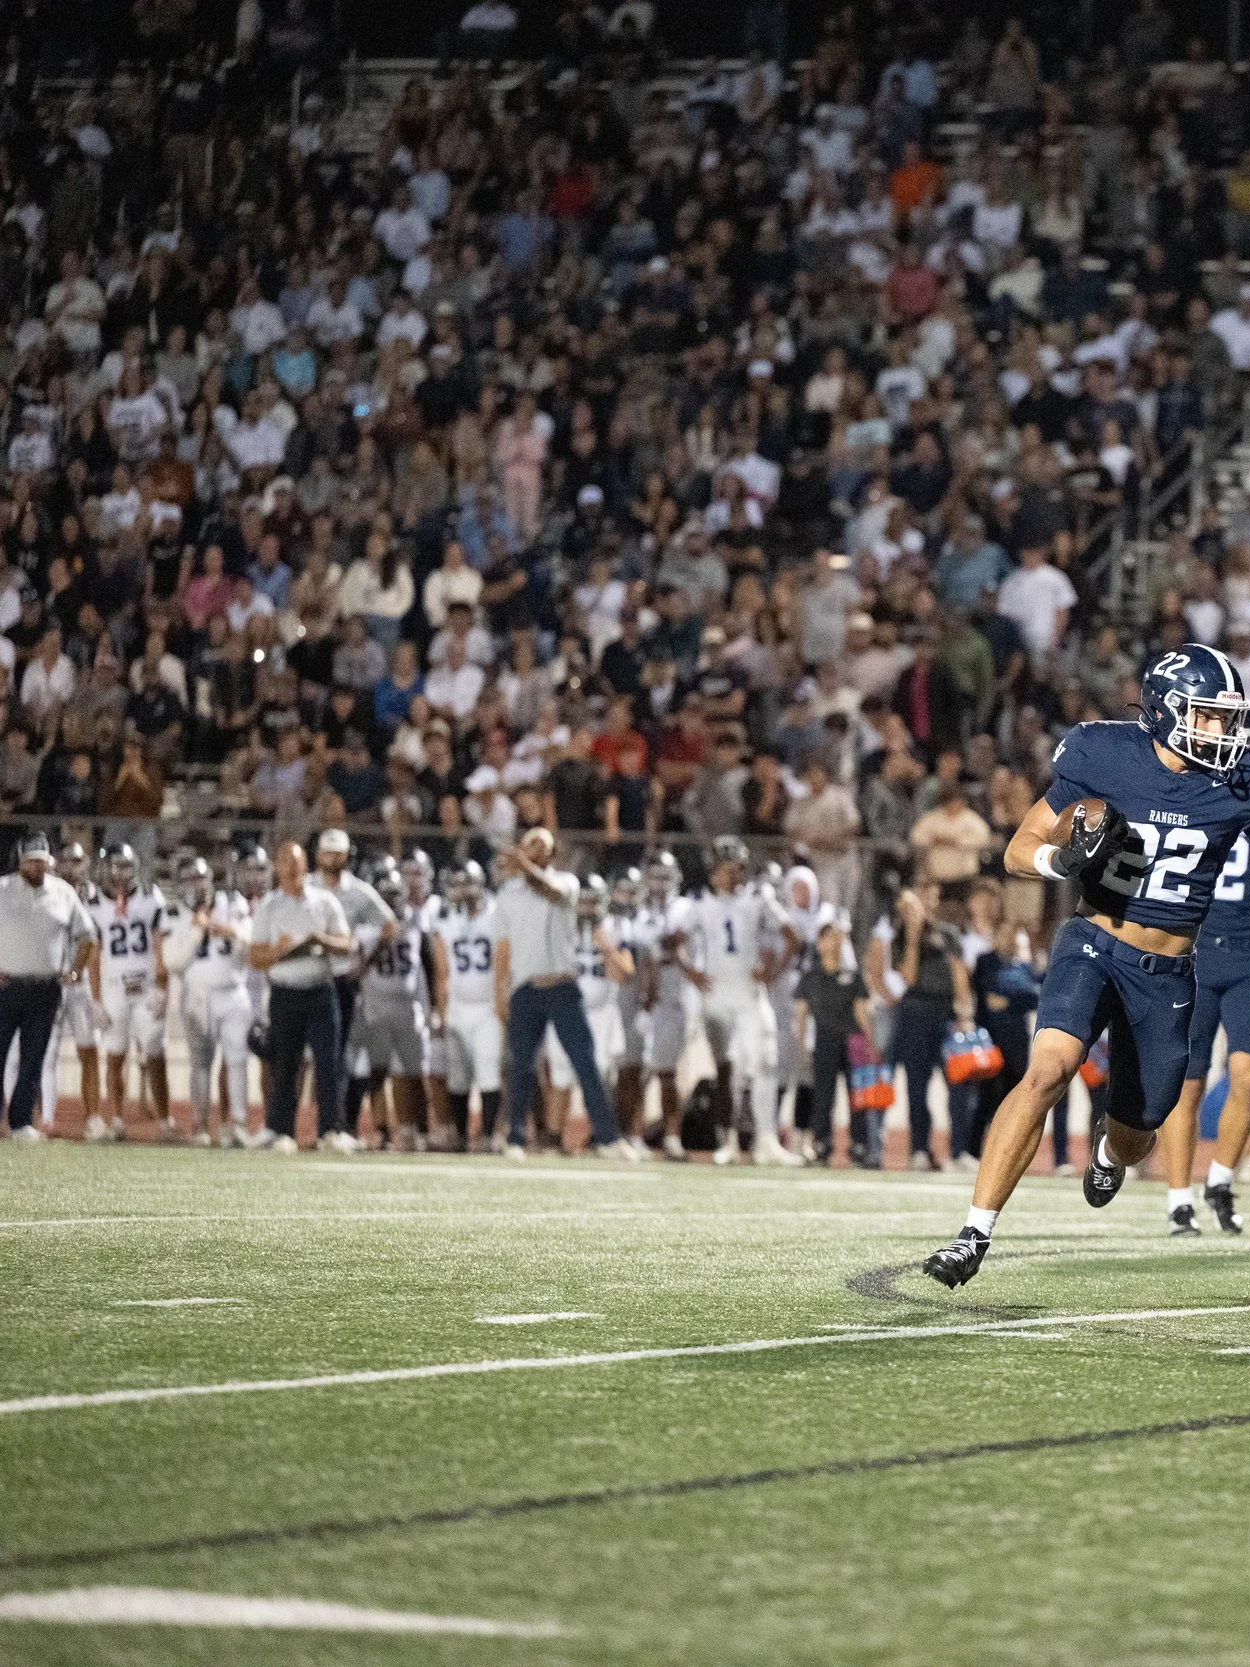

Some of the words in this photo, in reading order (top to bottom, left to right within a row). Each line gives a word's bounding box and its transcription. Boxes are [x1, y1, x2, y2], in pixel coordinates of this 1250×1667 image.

[1152, 652, 1190, 681] 22
[1148, 809, 1189, 827] RANGERS
[1099, 821, 1209, 903] 22
[109, 920, 148, 957] 23
[724, 919, 737, 953] 1
[452, 938, 492, 974] 53
